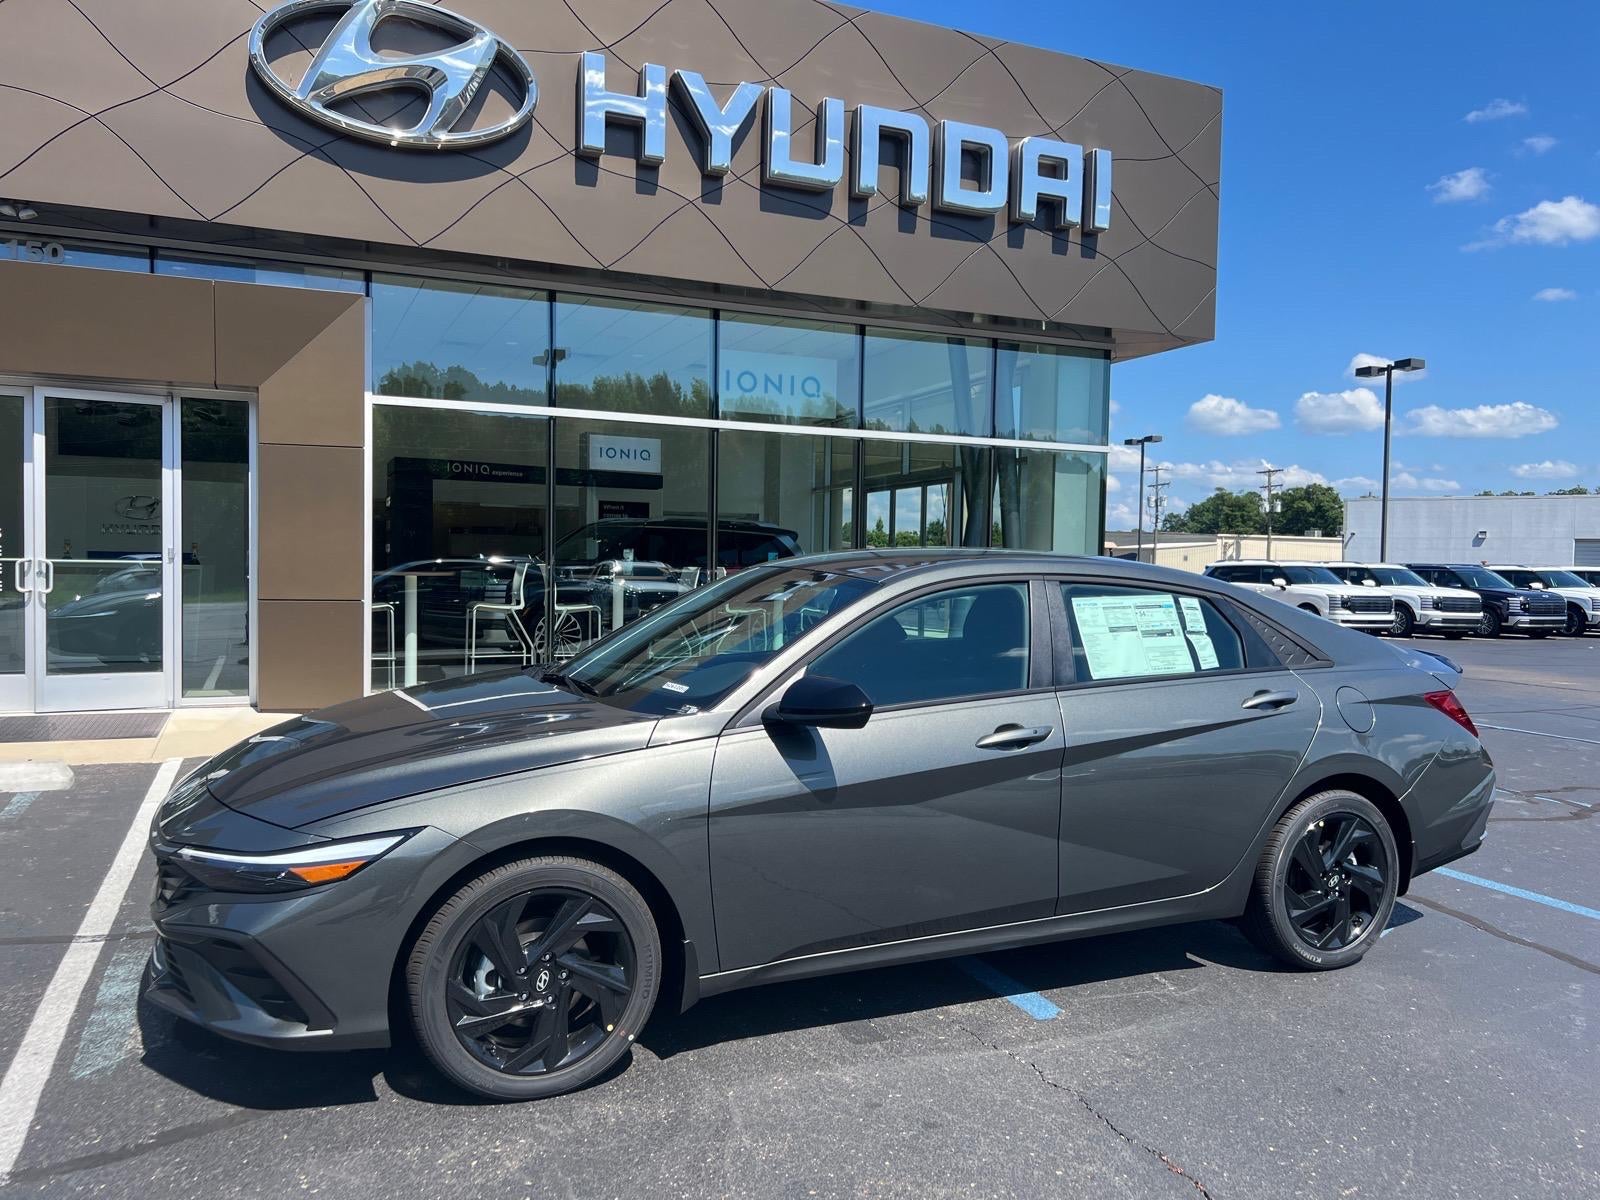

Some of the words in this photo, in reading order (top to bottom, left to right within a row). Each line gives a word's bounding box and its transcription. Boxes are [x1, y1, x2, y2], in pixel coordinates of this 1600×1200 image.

[576, 50, 1113, 234] HYUNDAI
[725, 369, 822, 399] IONIQ
[599, 447, 651, 461] IONIQ
[447, 462, 490, 475] IONIQ
[1293, 943, 1322, 963] KUMHO
